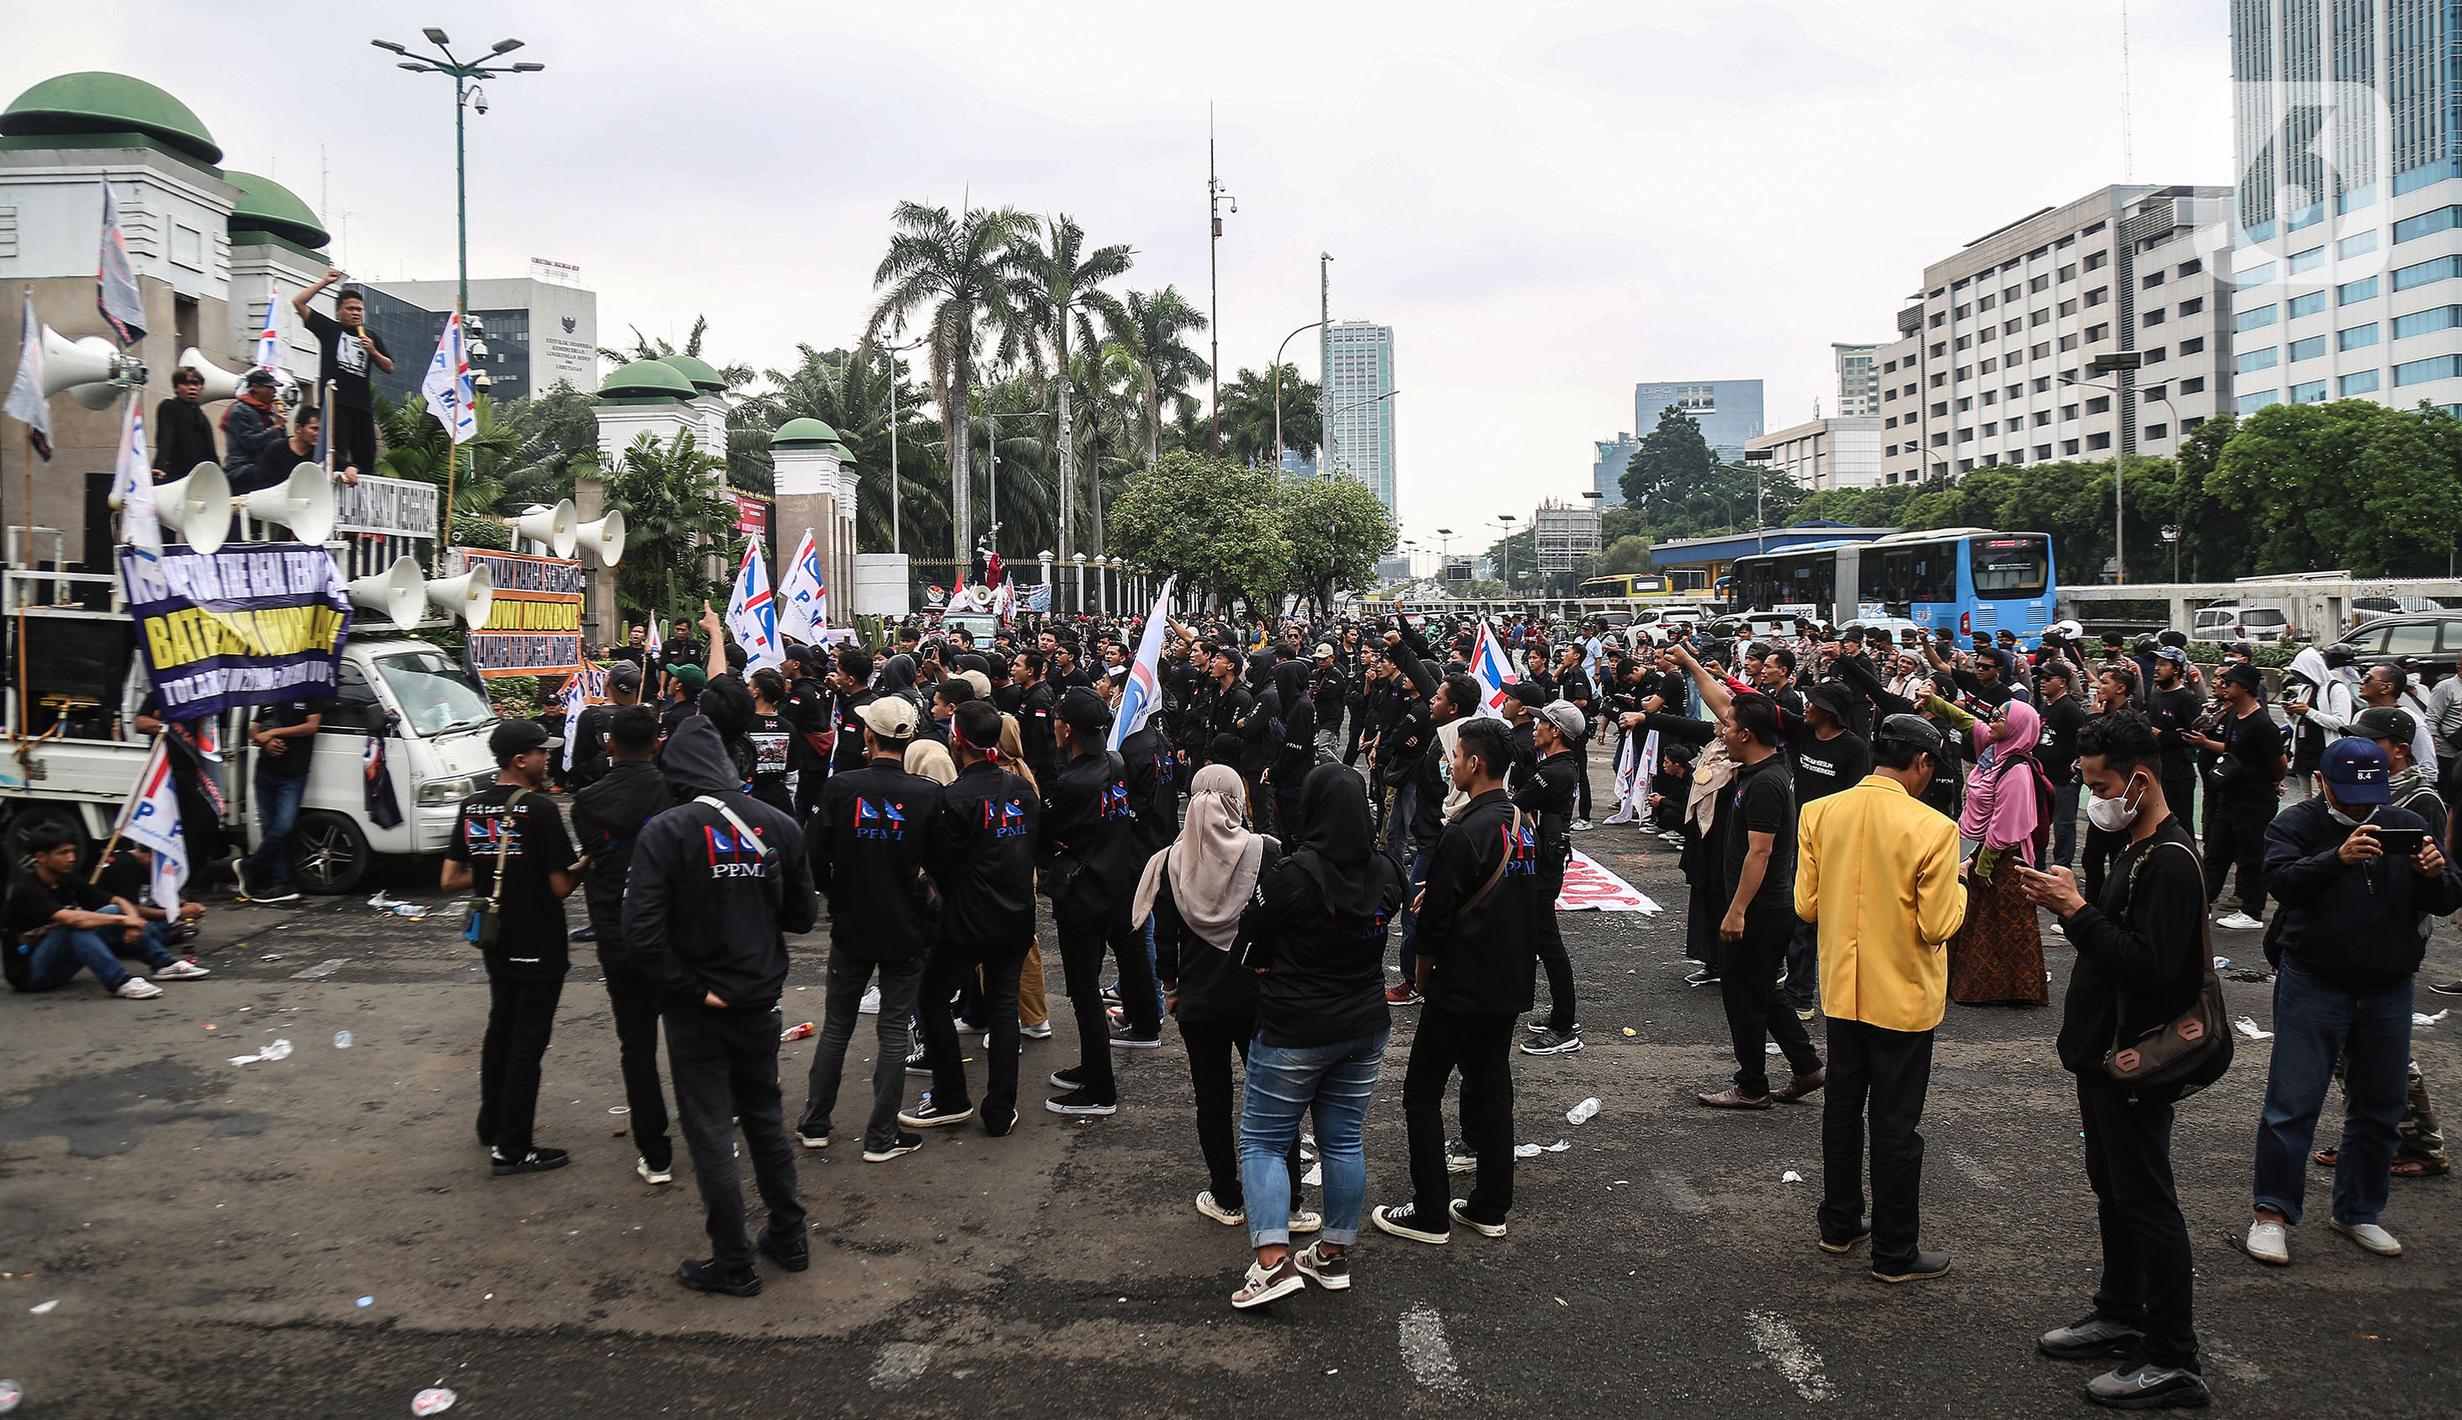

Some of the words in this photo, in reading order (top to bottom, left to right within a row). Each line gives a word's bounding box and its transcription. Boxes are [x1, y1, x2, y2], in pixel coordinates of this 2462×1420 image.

[2357, 772, 2372, 780] 8.4
[996, 826, 1028, 839] PMI
[711, 862, 765, 879] PPMI
